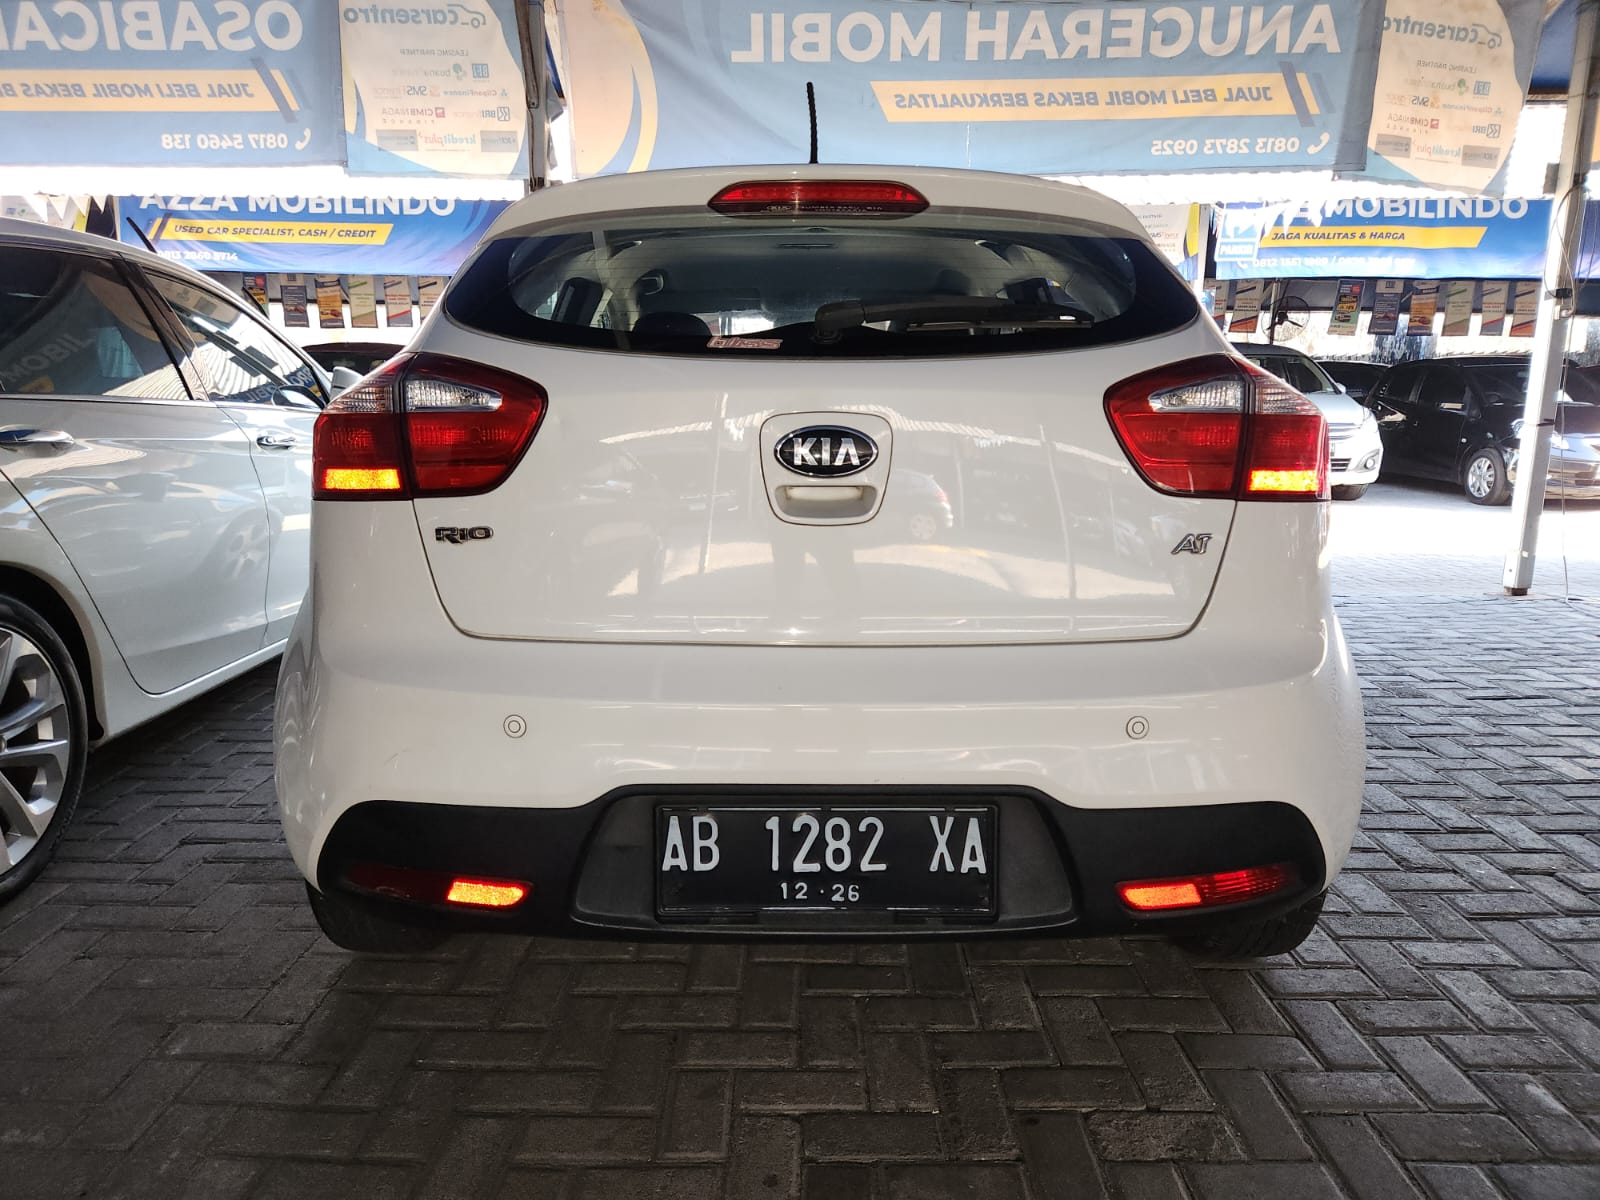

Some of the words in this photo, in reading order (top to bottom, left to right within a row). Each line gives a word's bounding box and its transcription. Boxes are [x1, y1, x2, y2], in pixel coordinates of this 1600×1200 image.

[249, 195, 455, 216] MOBILINDO
[174, 225, 203, 235] USED
[207, 227, 229, 235] CAR
[232, 227, 295, 238] SPECIALIST,
[298, 229, 326, 238] CASH
[337, 229, 377, 239] CREDIT
[1272, 232, 1300, 241] JAGA
[1304, 231, 1356, 241] KUALITAS
[1359, 231, 1366, 240] &
[1369, 231, 1405, 241] HARGA
[792, 437, 860, 466] KIA
[435, 526, 494, 545] RIO
[661, 815, 720, 872] AB
[765, 815, 887, 873] 1282
[929, 815, 987, 874] XA
[780, 882, 808, 900] 12
[831, 883, 859, 901] 26
